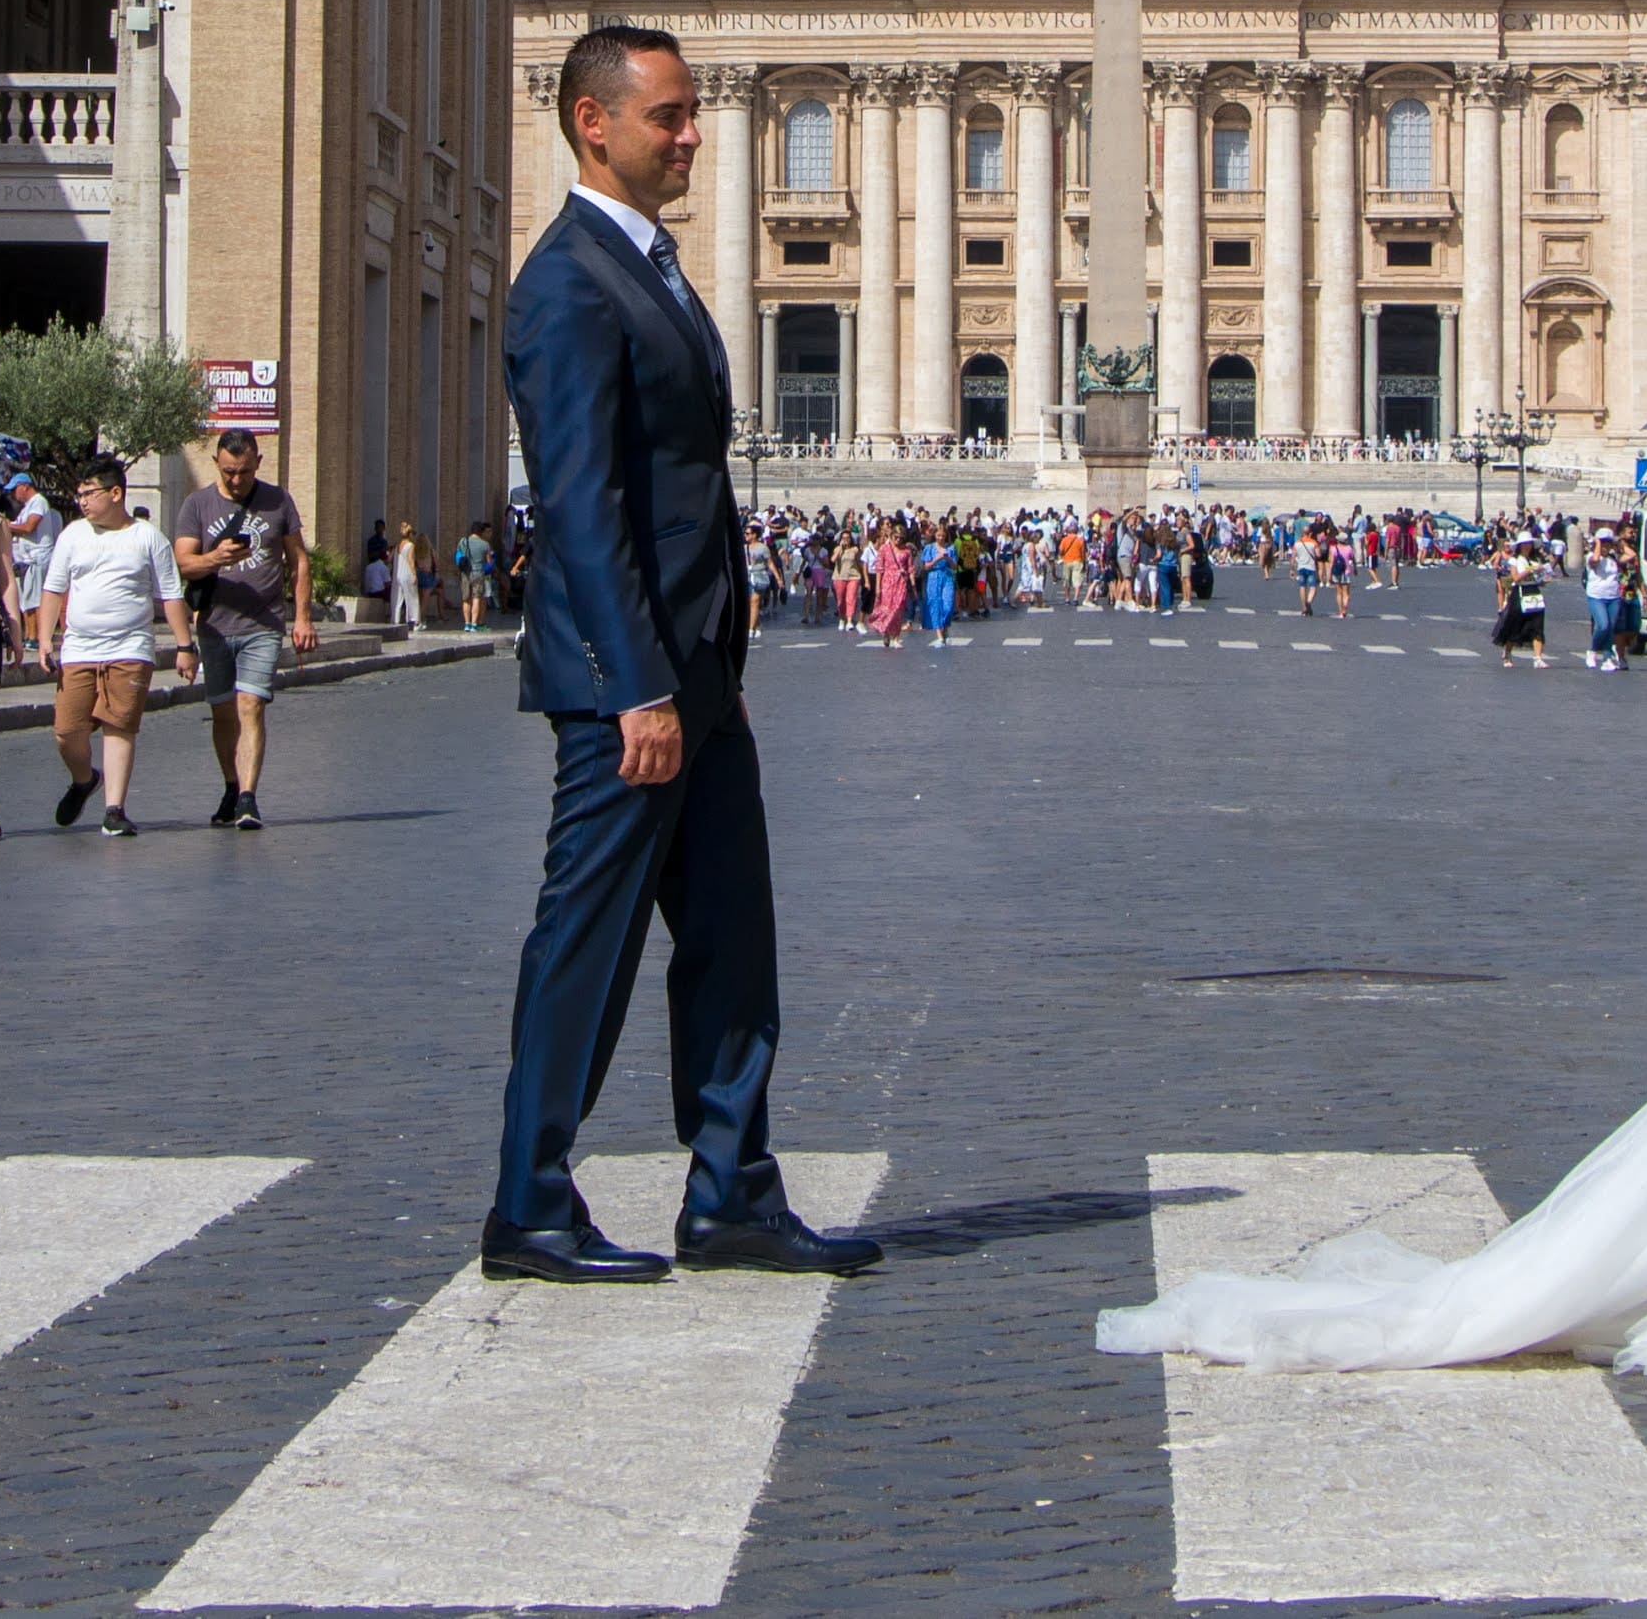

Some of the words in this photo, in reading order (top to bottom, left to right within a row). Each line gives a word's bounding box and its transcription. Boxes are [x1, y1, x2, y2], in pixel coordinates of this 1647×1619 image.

[552, 13, 579, 30] IN
[591, 13, 715, 31] HONOREM
[718, 13, 837, 30] PRINCIPIS
[919, 12, 996, 29] PAVLVS
[1176, 12, 1297, 29] ROMANVS
[1305, 12, 1363, 29] PONT
[1368, 13, 1418, 29] MAX
[4, 185, 61, 203] PONT
[209, 371, 249, 386] CENTRO
[211, 387, 230, 404] AN
[231, 387, 277, 404] LORENZO
